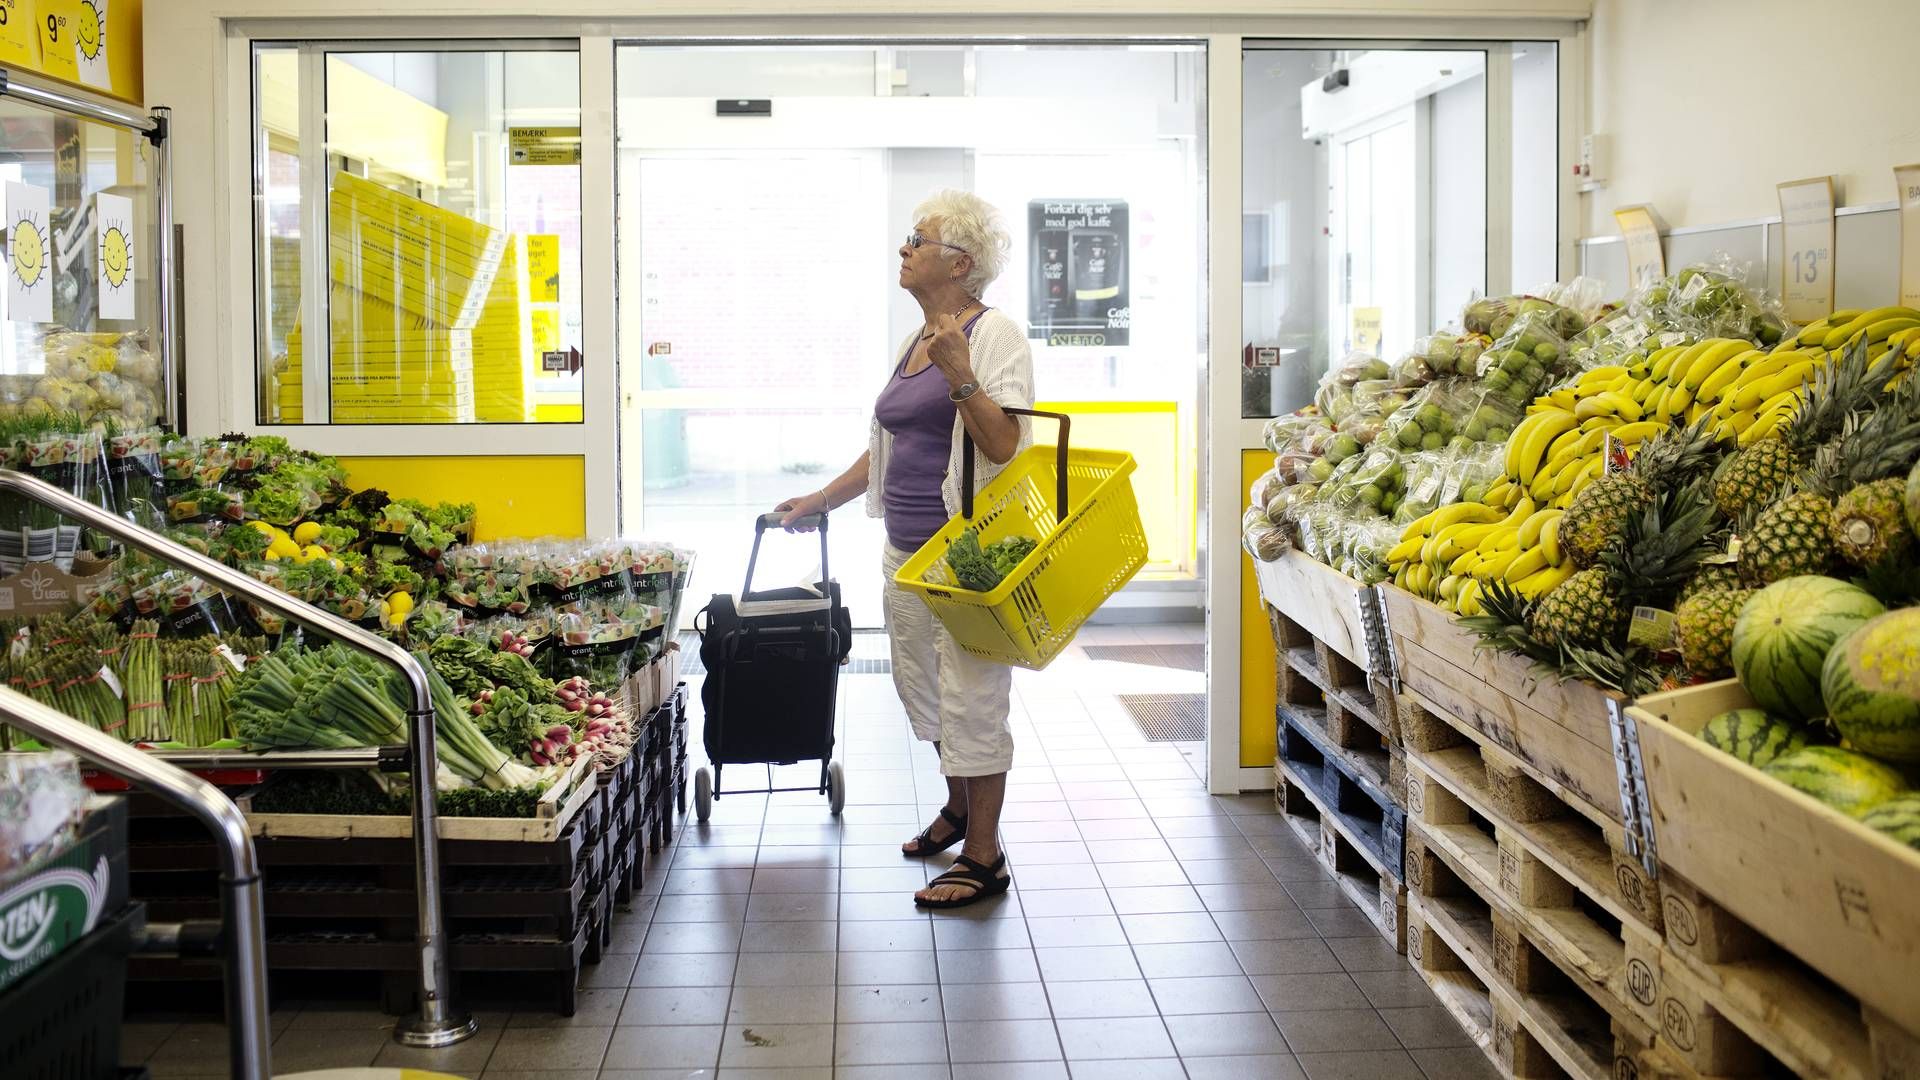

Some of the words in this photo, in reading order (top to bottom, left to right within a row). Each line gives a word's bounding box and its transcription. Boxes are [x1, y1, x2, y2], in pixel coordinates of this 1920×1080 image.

[513, 129, 547, 137] BEMÆRK!
[1044, 204, 1075, 214] Forkæl
[1077, 203, 1093, 217] dig
[1095, 203, 1113, 214] selv
[1045, 216, 1066, 227] med
[1067, 216, 1086, 230] god
[1087, 216, 1111, 227] kaffe
[1792, 250, 1817, 283] 13
[1056, 335, 1105, 346] NETTO
[0, 890, 48, 945] TEN
